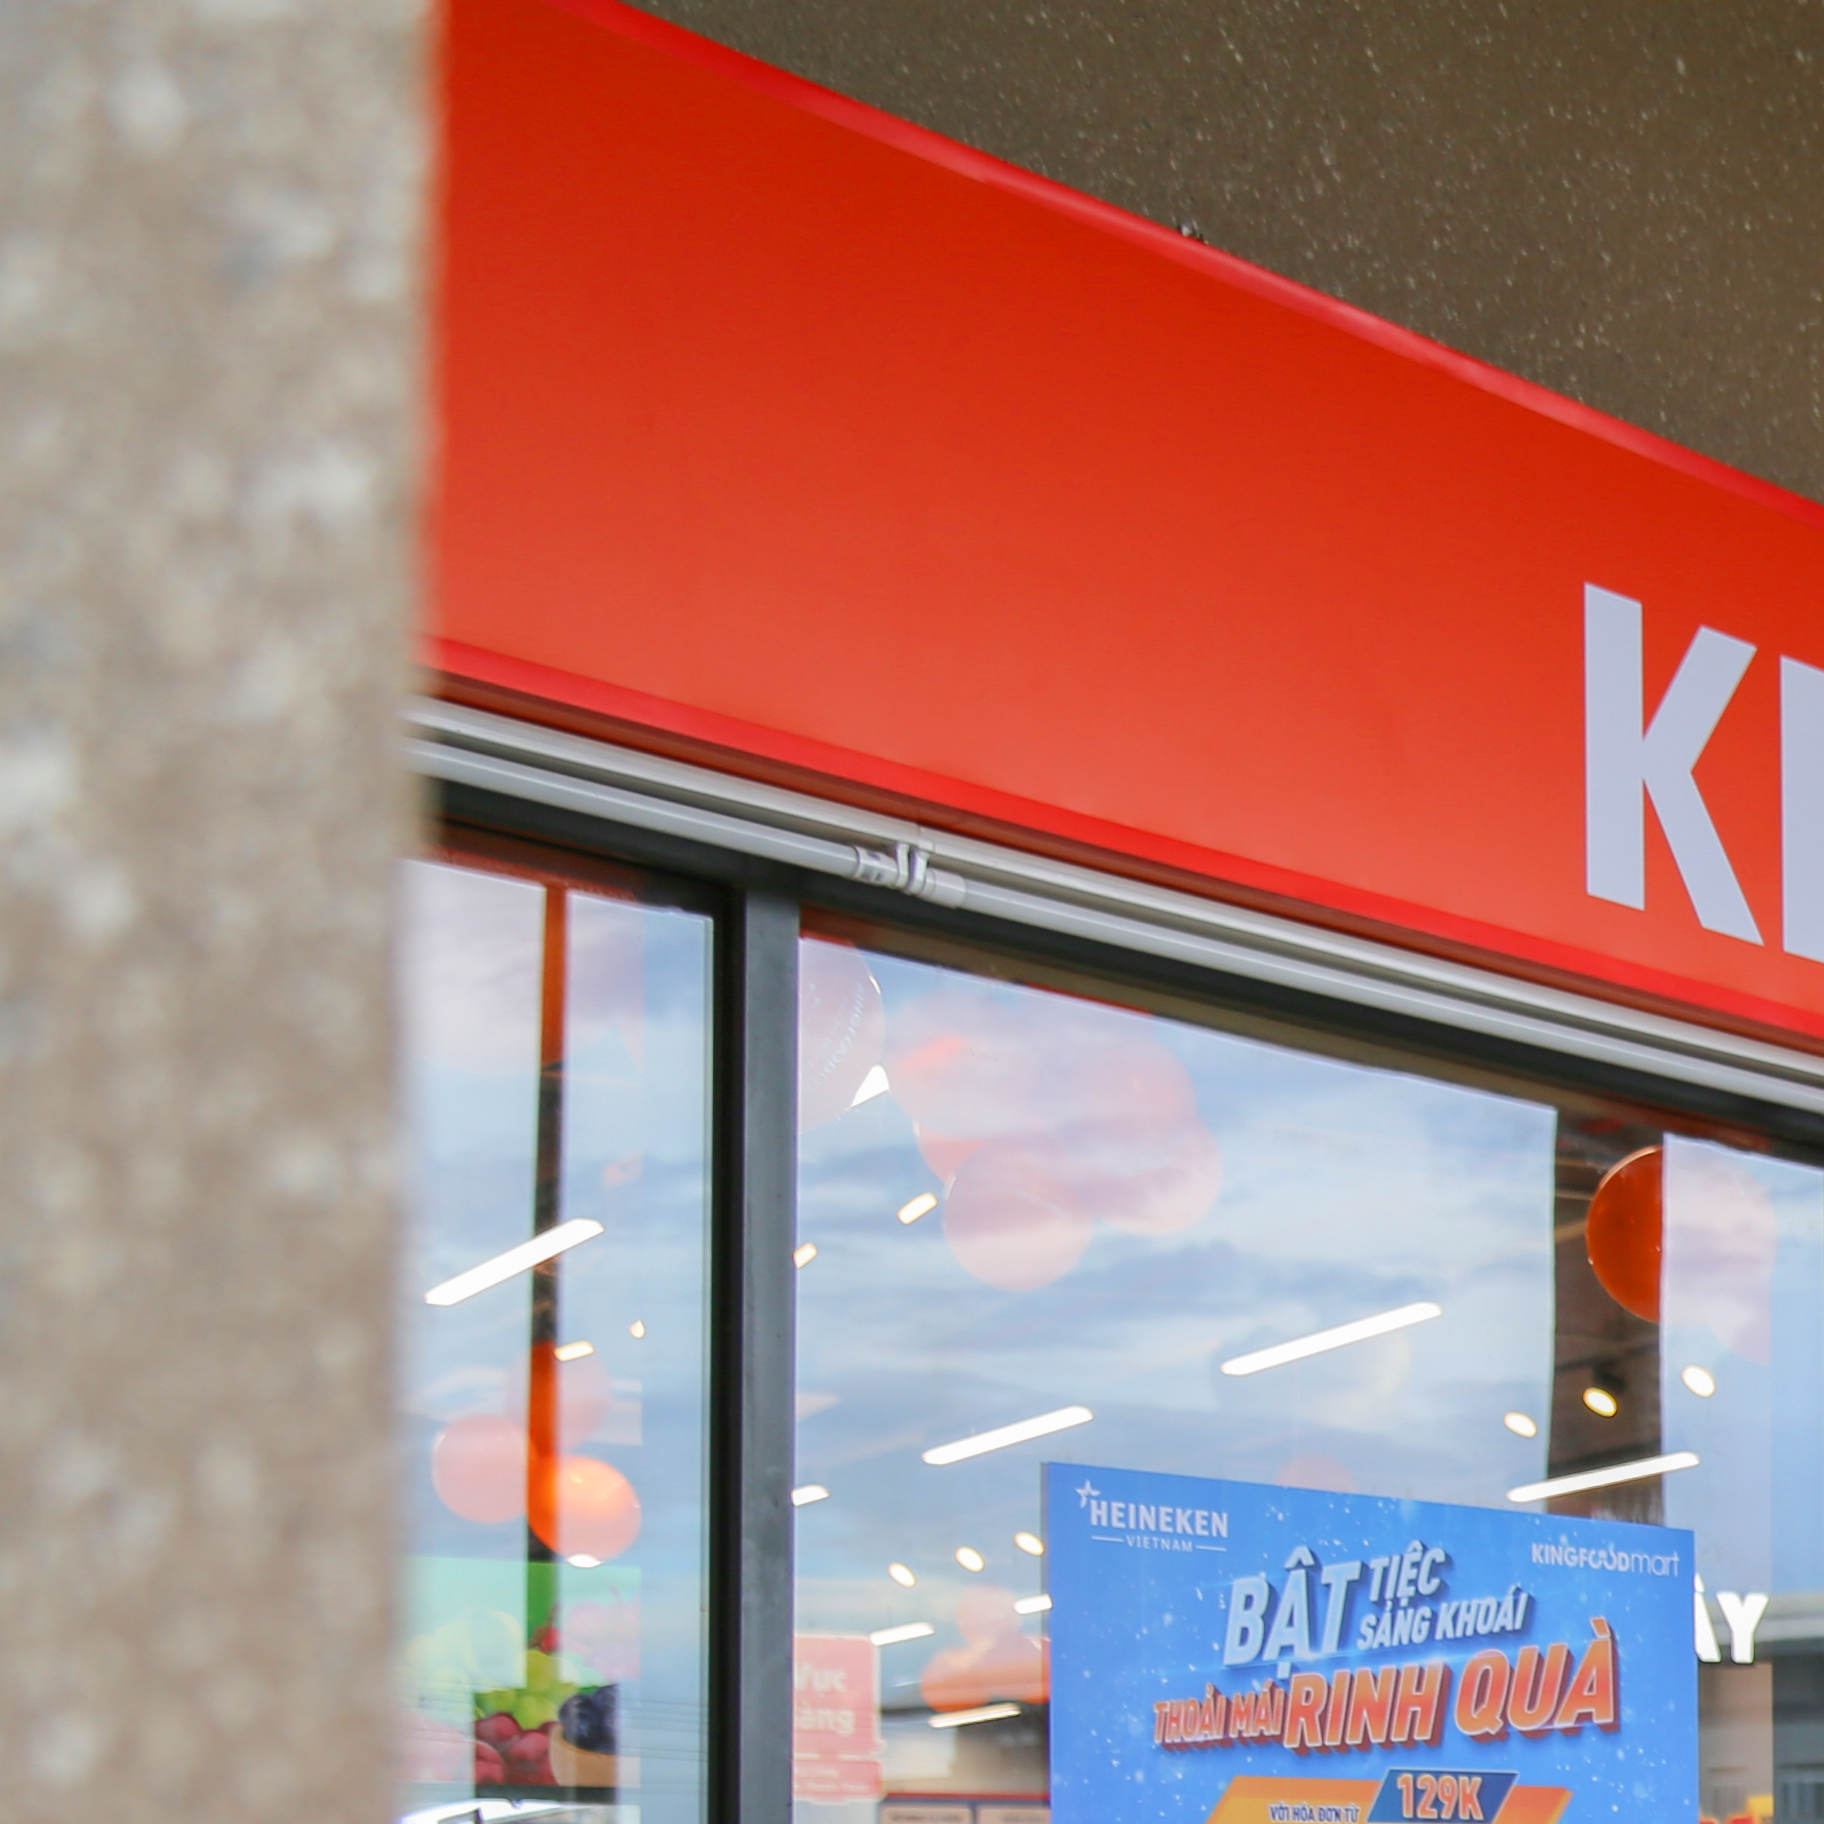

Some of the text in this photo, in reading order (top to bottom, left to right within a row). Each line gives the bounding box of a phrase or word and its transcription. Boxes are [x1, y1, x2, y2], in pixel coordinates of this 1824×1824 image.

[1090, 1499, 1229, 1538] HEINEKEN
[1126, 1535, 1193, 1552] VIETNAM
[1369, 1539, 1447, 1607] TIỆC
[1531, 1542, 1680, 1577] KINGFOODmart
[1223, 1546, 1363, 1679] BẬT
[1357, 1584, 1529, 1651] SẢNG KHOÁI
[1229, 1678, 1285, 1739] MÁI
[1283, 1660, 1446, 1749] RINH
[1454, 1616, 1615, 1737] QUÀ
[1396, 1773, 1485, 1821] 129K
